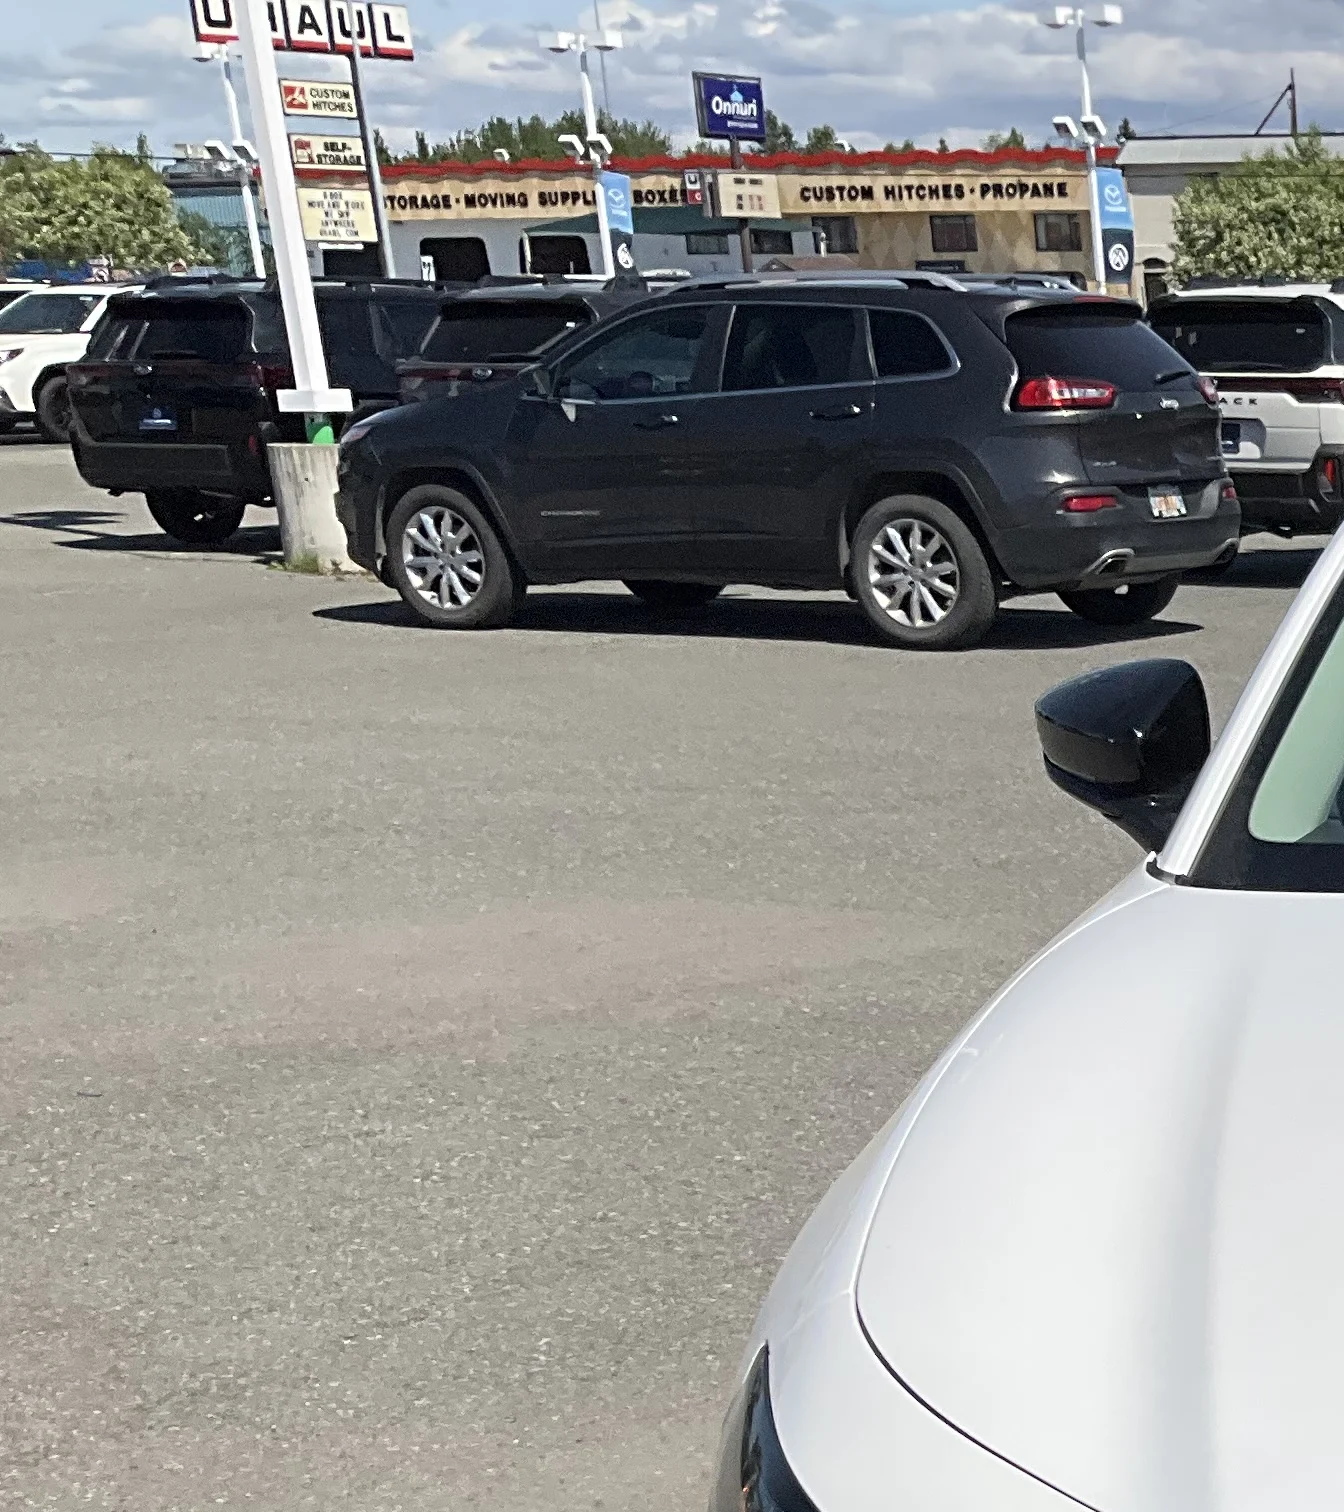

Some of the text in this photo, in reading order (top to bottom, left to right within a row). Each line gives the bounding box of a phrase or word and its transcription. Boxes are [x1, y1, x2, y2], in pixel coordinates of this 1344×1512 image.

[309, 87, 350, 99] CUSTOM
[311, 100, 353, 112] HITCHES
[711, 95, 757, 117] Onnuri
[316, 153, 362, 165] STORAGE
[800, 181, 1069, 201] CUSTOM HITCHES PROPANE
[464, 191, 529, 209] MOVING
